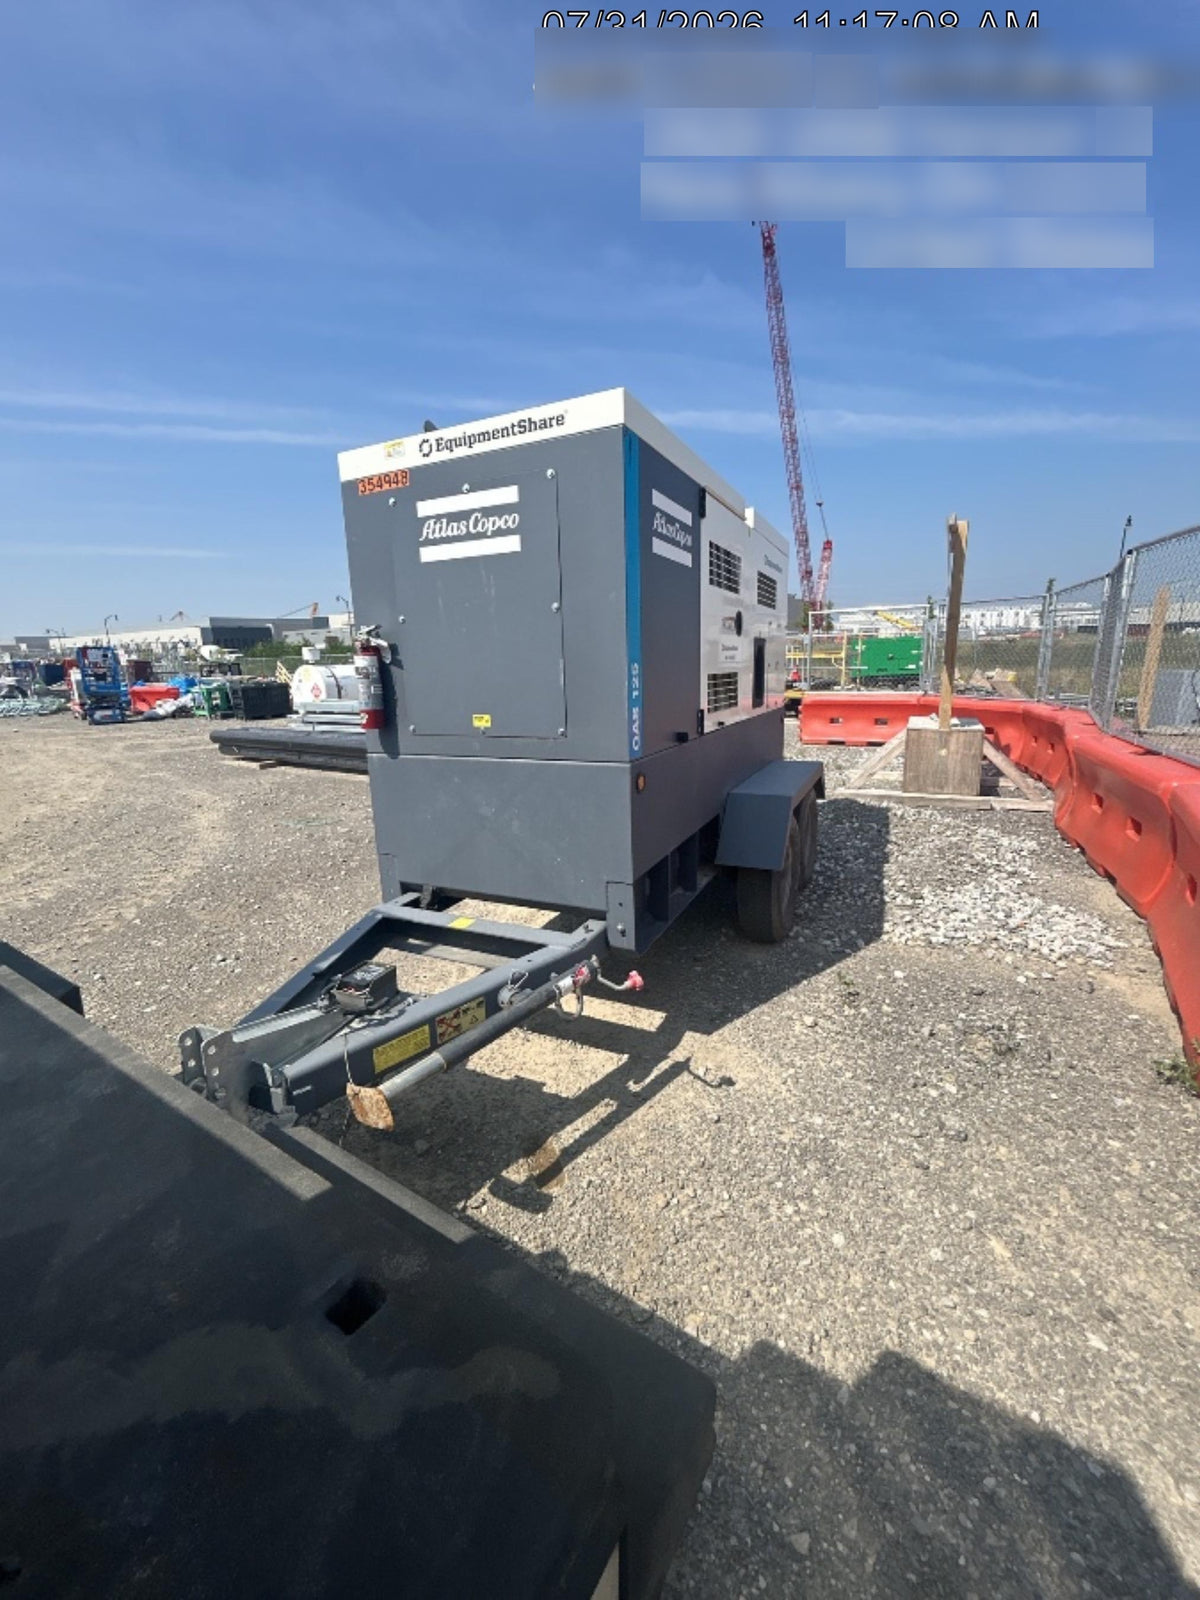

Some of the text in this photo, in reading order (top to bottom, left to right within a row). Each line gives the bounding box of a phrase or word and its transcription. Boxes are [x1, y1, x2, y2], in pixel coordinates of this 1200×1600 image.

[434, 413, 566, 452] EquipmentShare
[358, 470, 409, 493] 354948
[419, 512, 520, 541] Atlas Copco
